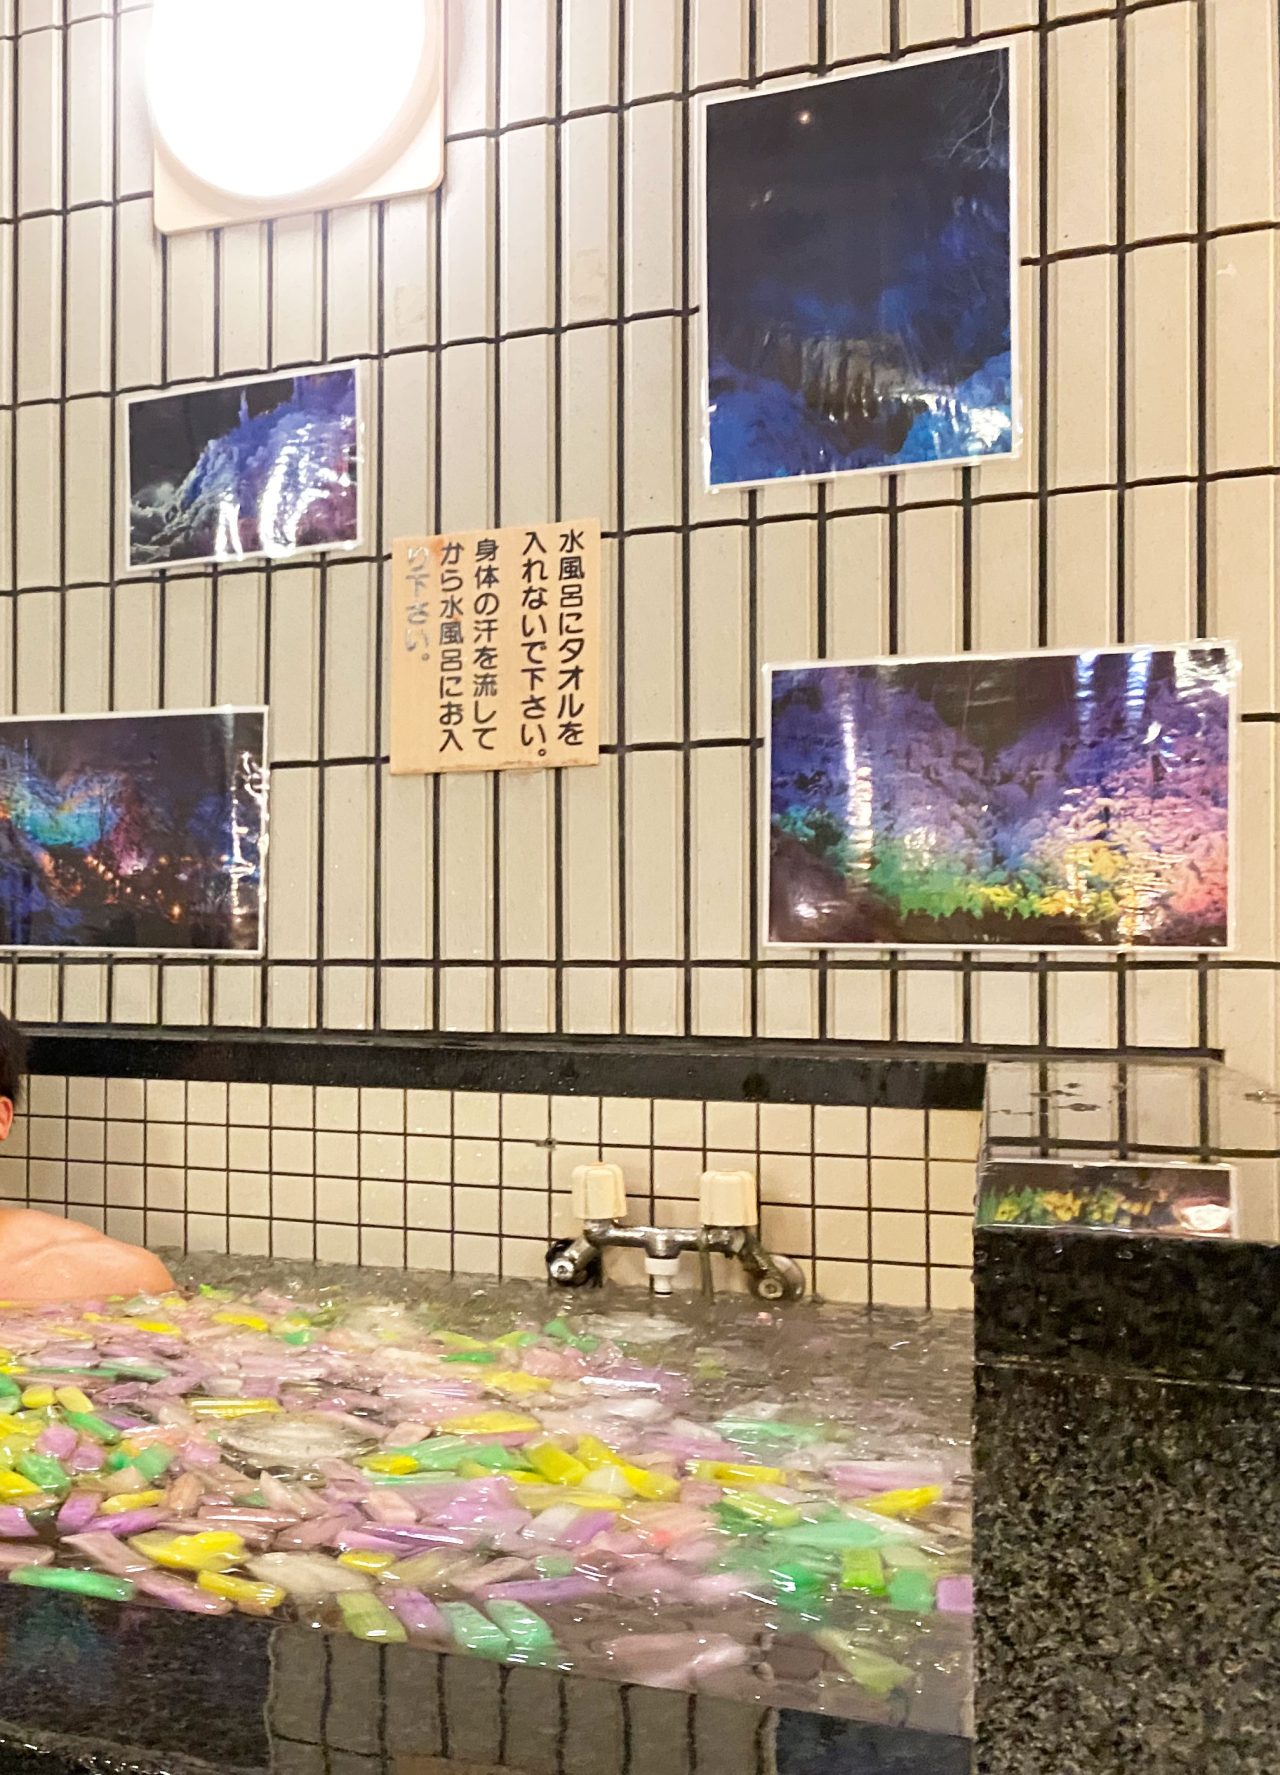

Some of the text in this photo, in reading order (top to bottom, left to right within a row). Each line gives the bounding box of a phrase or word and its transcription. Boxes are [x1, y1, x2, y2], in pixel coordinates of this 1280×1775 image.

[439, 541, 464, 752] から水風呂にお入
[472, 538, 500, 750] 身体の汗を流して
[520, 531, 548, 757] 入れないで下さい。
[558, 529, 585, 746] 水風呂にタオルを
